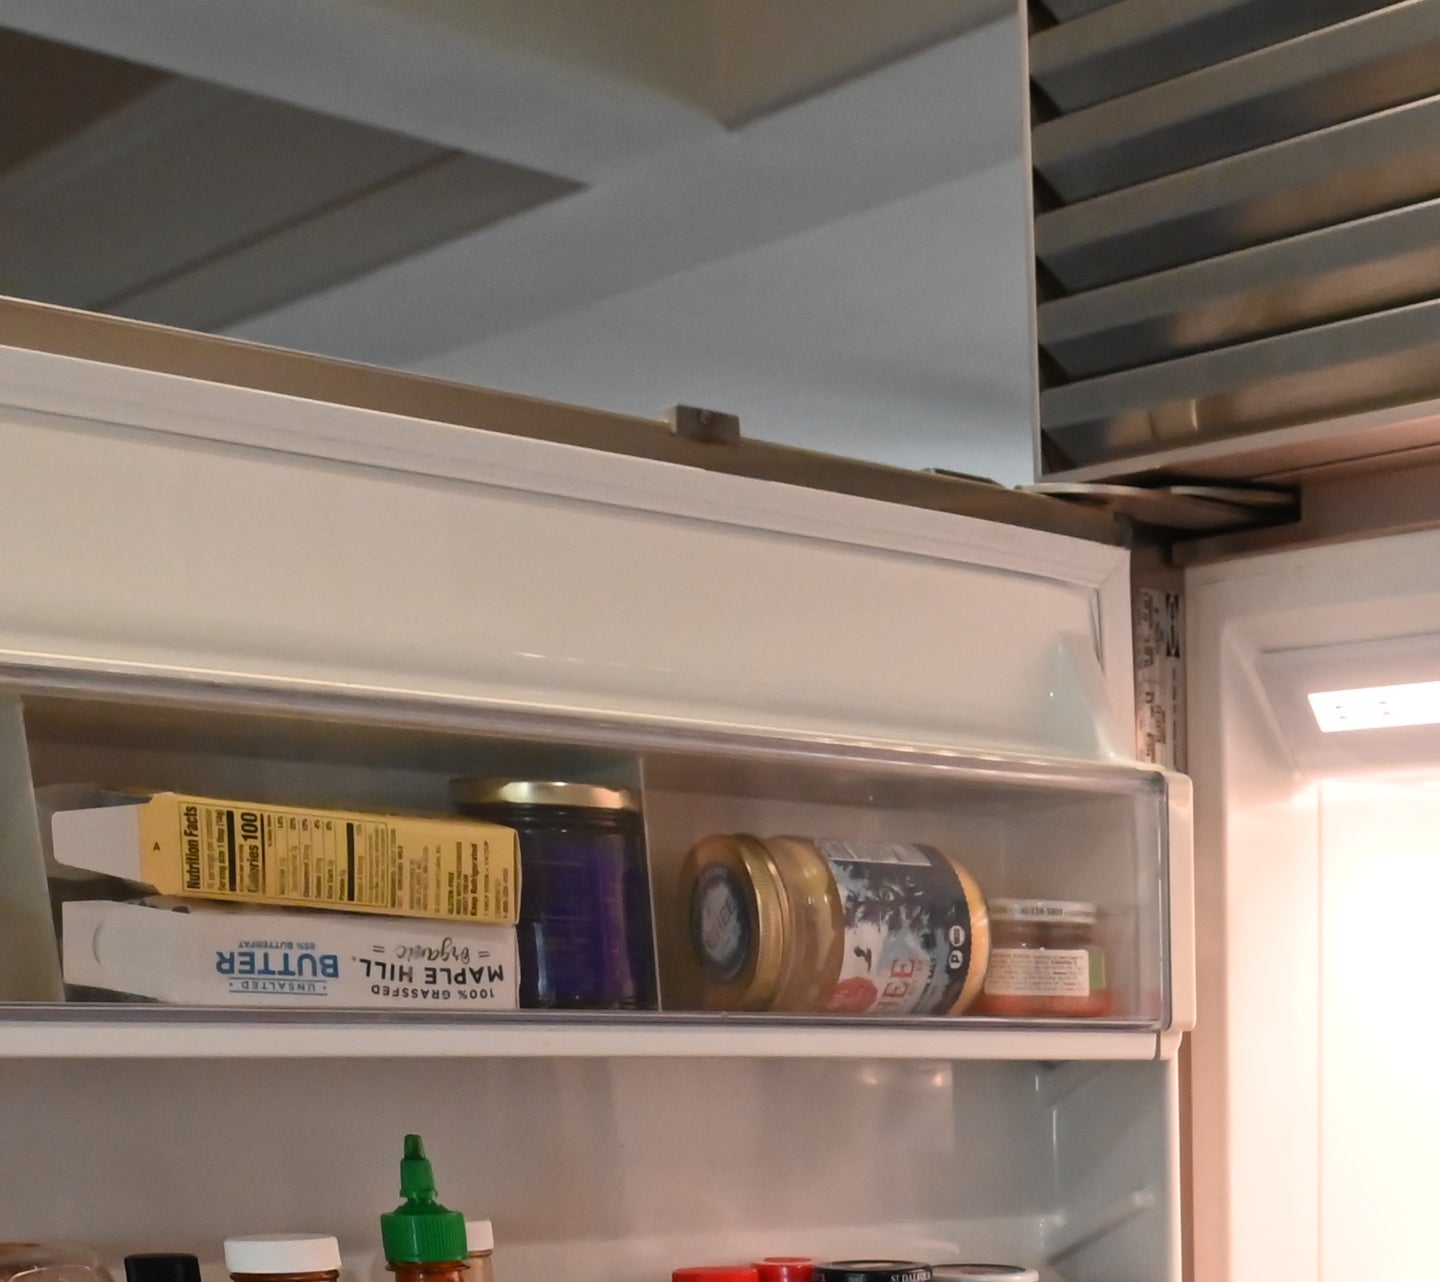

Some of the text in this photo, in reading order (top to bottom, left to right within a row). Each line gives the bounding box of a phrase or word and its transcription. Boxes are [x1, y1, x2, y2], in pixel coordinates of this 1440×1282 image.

[183, 806, 201, 889] Nutrition Facts
[240, 812, 261, 892] Calories 100
[215, 951, 339, 978] BUTTER
[359, 958, 504, 985] MAPLE HILL
[240, 980, 317, 992] UNSALTED
[371, 984, 495, 999] 100% GRASSFED
